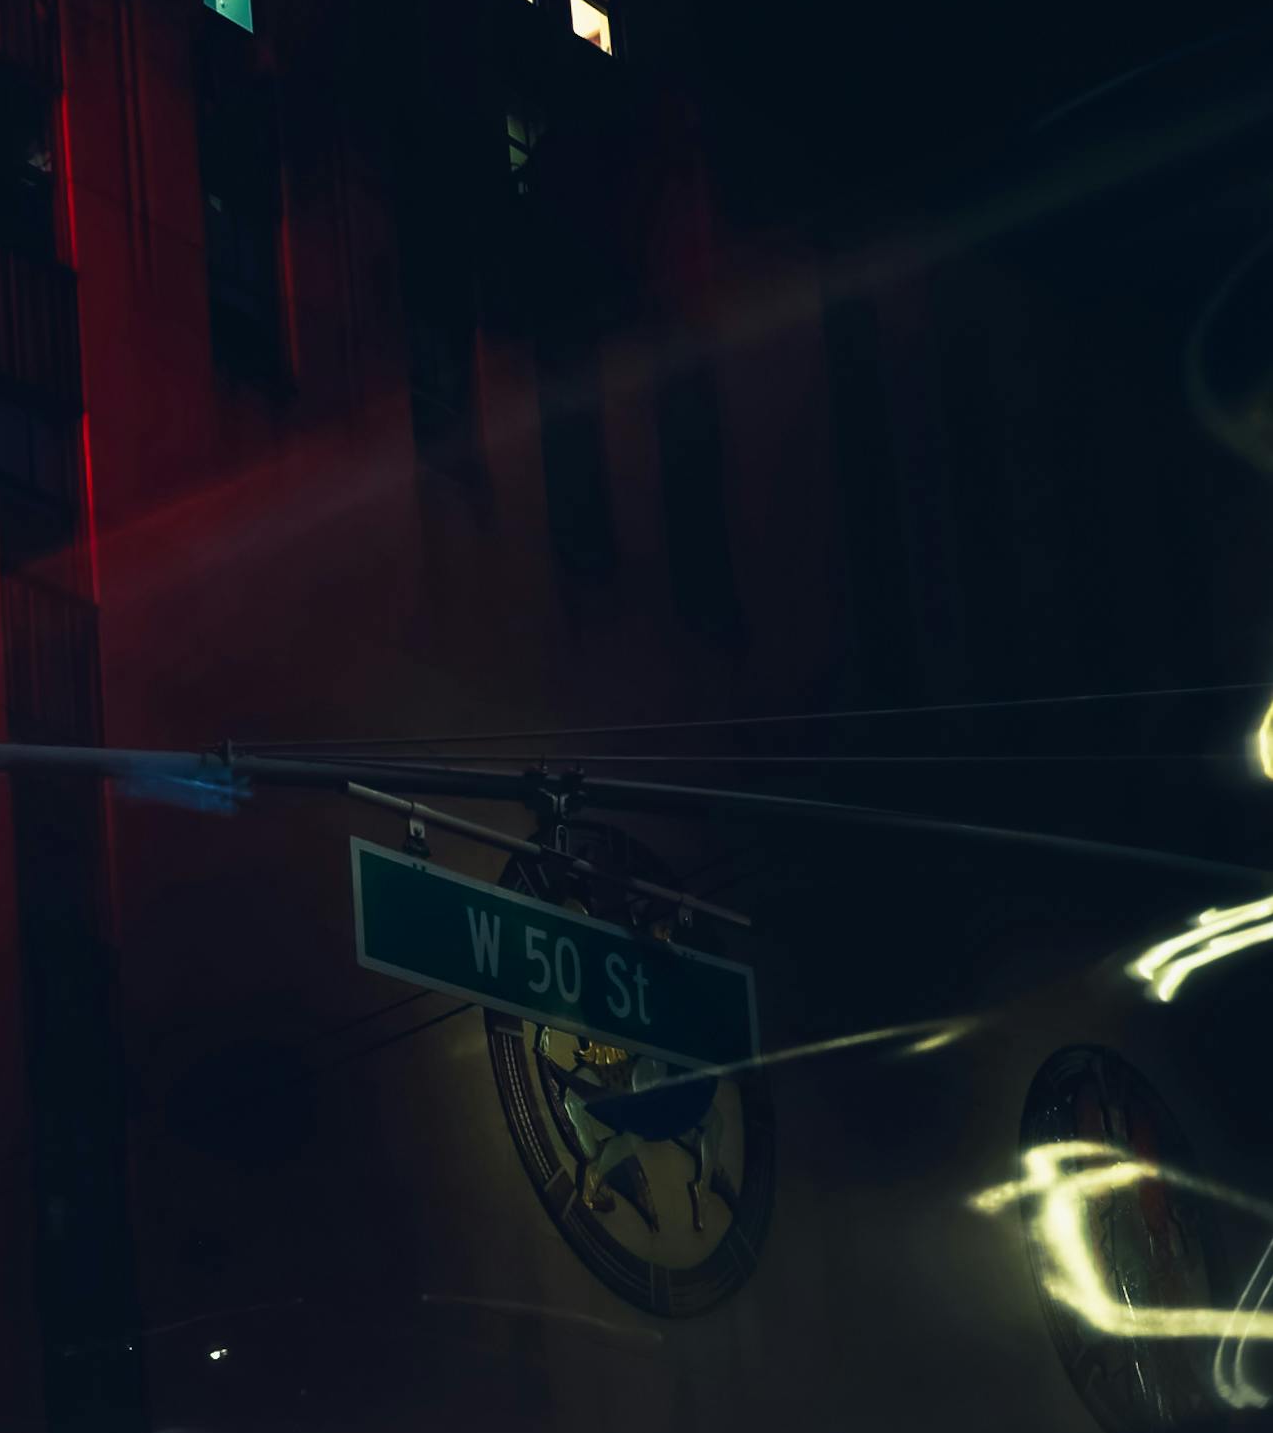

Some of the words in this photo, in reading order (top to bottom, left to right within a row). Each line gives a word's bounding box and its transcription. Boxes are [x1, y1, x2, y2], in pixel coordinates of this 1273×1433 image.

[466, 905, 501, 979] W
[525, 924, 582, 1004] 50
[605, 951, 652, 1027] St
